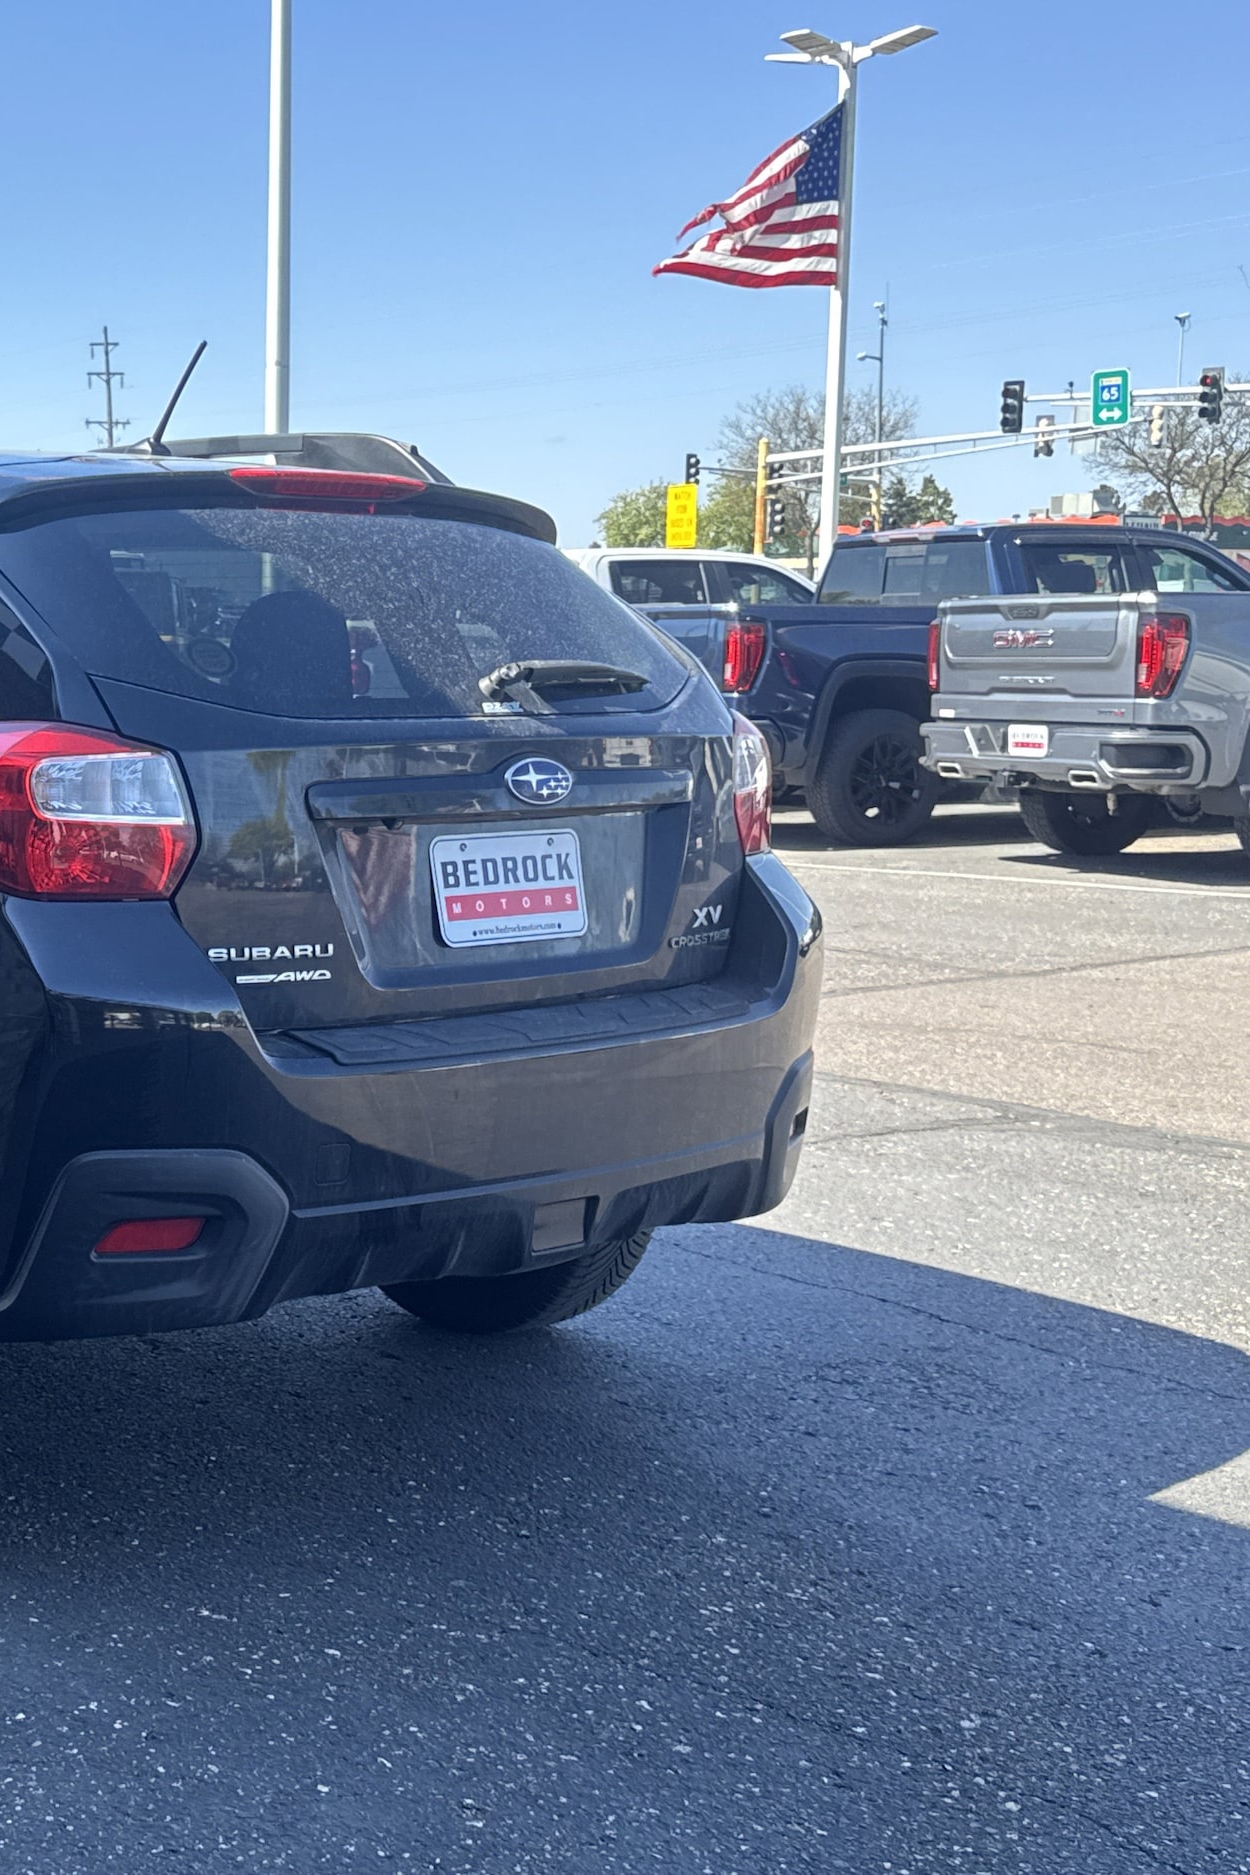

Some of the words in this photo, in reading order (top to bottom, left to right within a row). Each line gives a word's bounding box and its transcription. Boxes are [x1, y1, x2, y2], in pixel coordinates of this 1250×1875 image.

[1102, 386, 1119, 401] 65
[993, 630, 1054, 649] GMC
[440, 853, 575, 889] BEDROCK
[452, 893, 573, 914] MOTORS
[692, 904, 723, 929] XV
[207, 943, 334, 962] SUBARU
[272, 969, 332, 983] AWD
